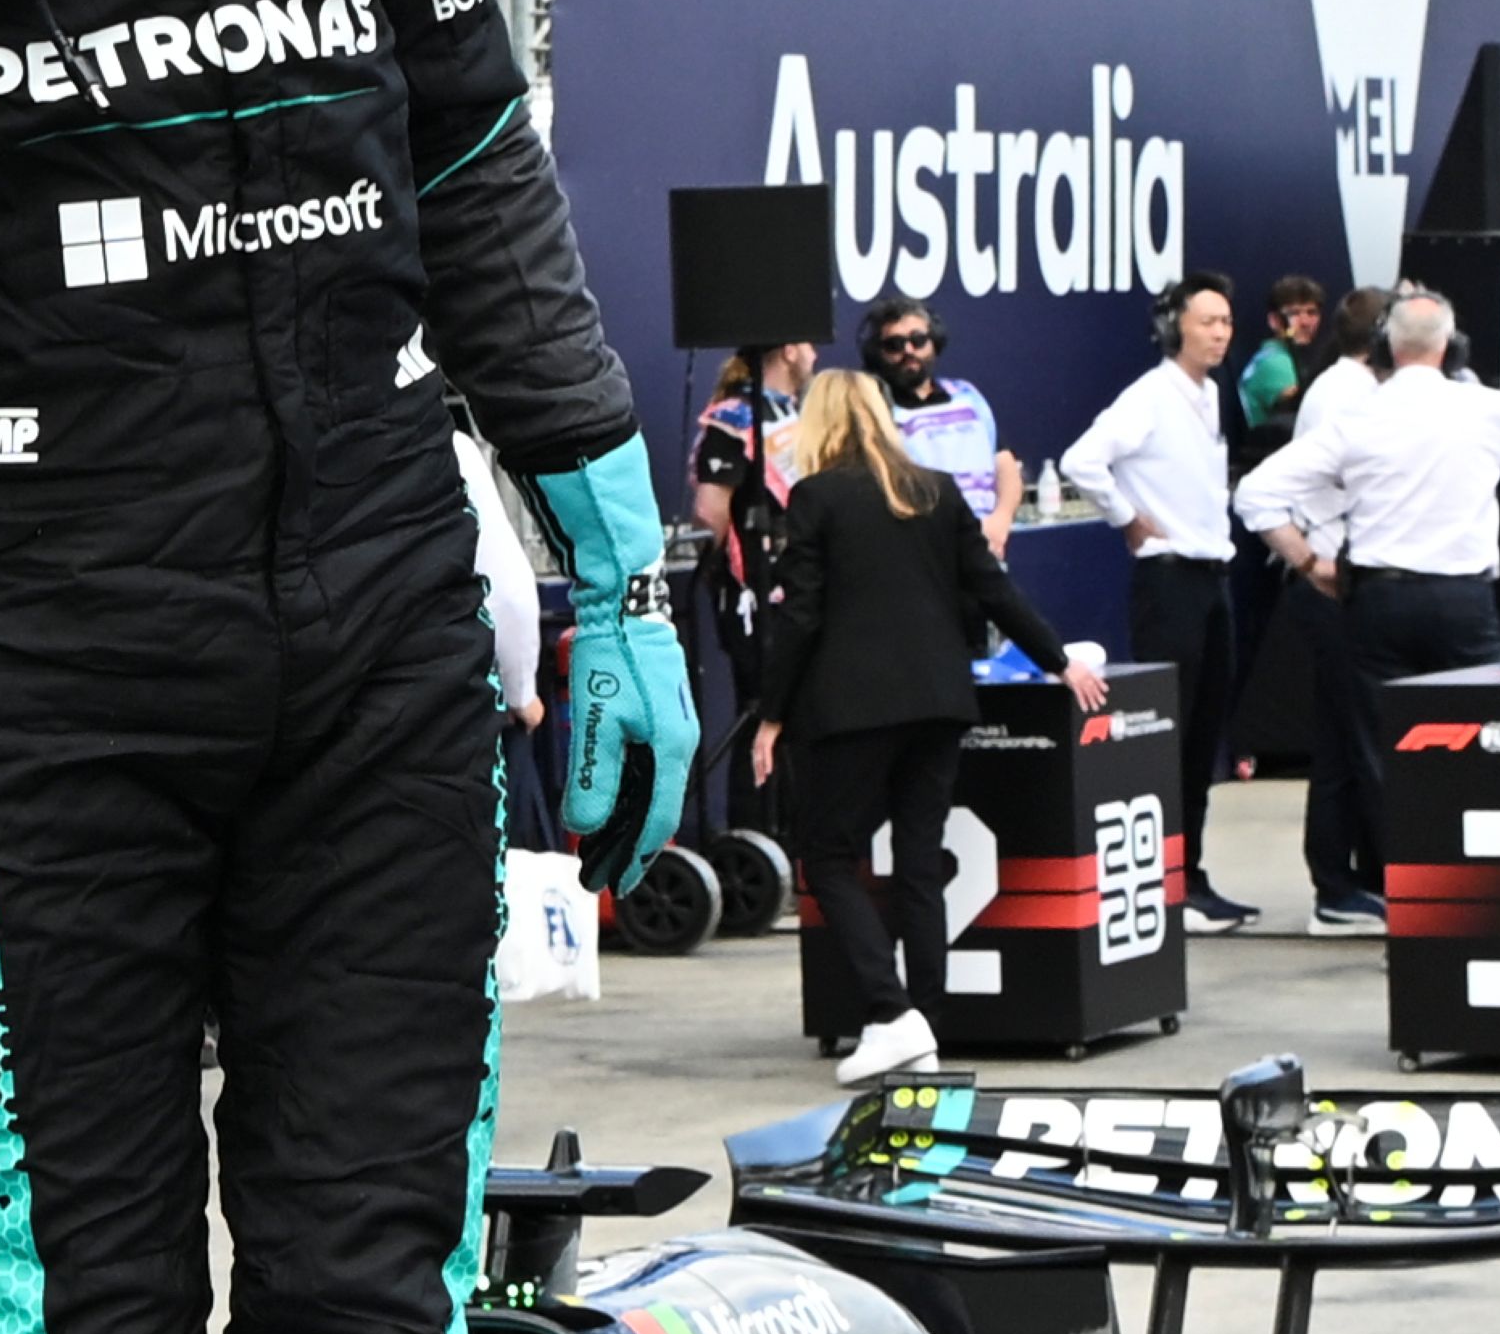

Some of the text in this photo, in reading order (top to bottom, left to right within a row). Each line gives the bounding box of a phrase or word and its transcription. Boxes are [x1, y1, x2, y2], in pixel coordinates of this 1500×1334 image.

[162, 177, 384, 265] Microsoft
[763, 53, 1185, 299] Australia
[578, 701, 602, 791] WhatsApp
